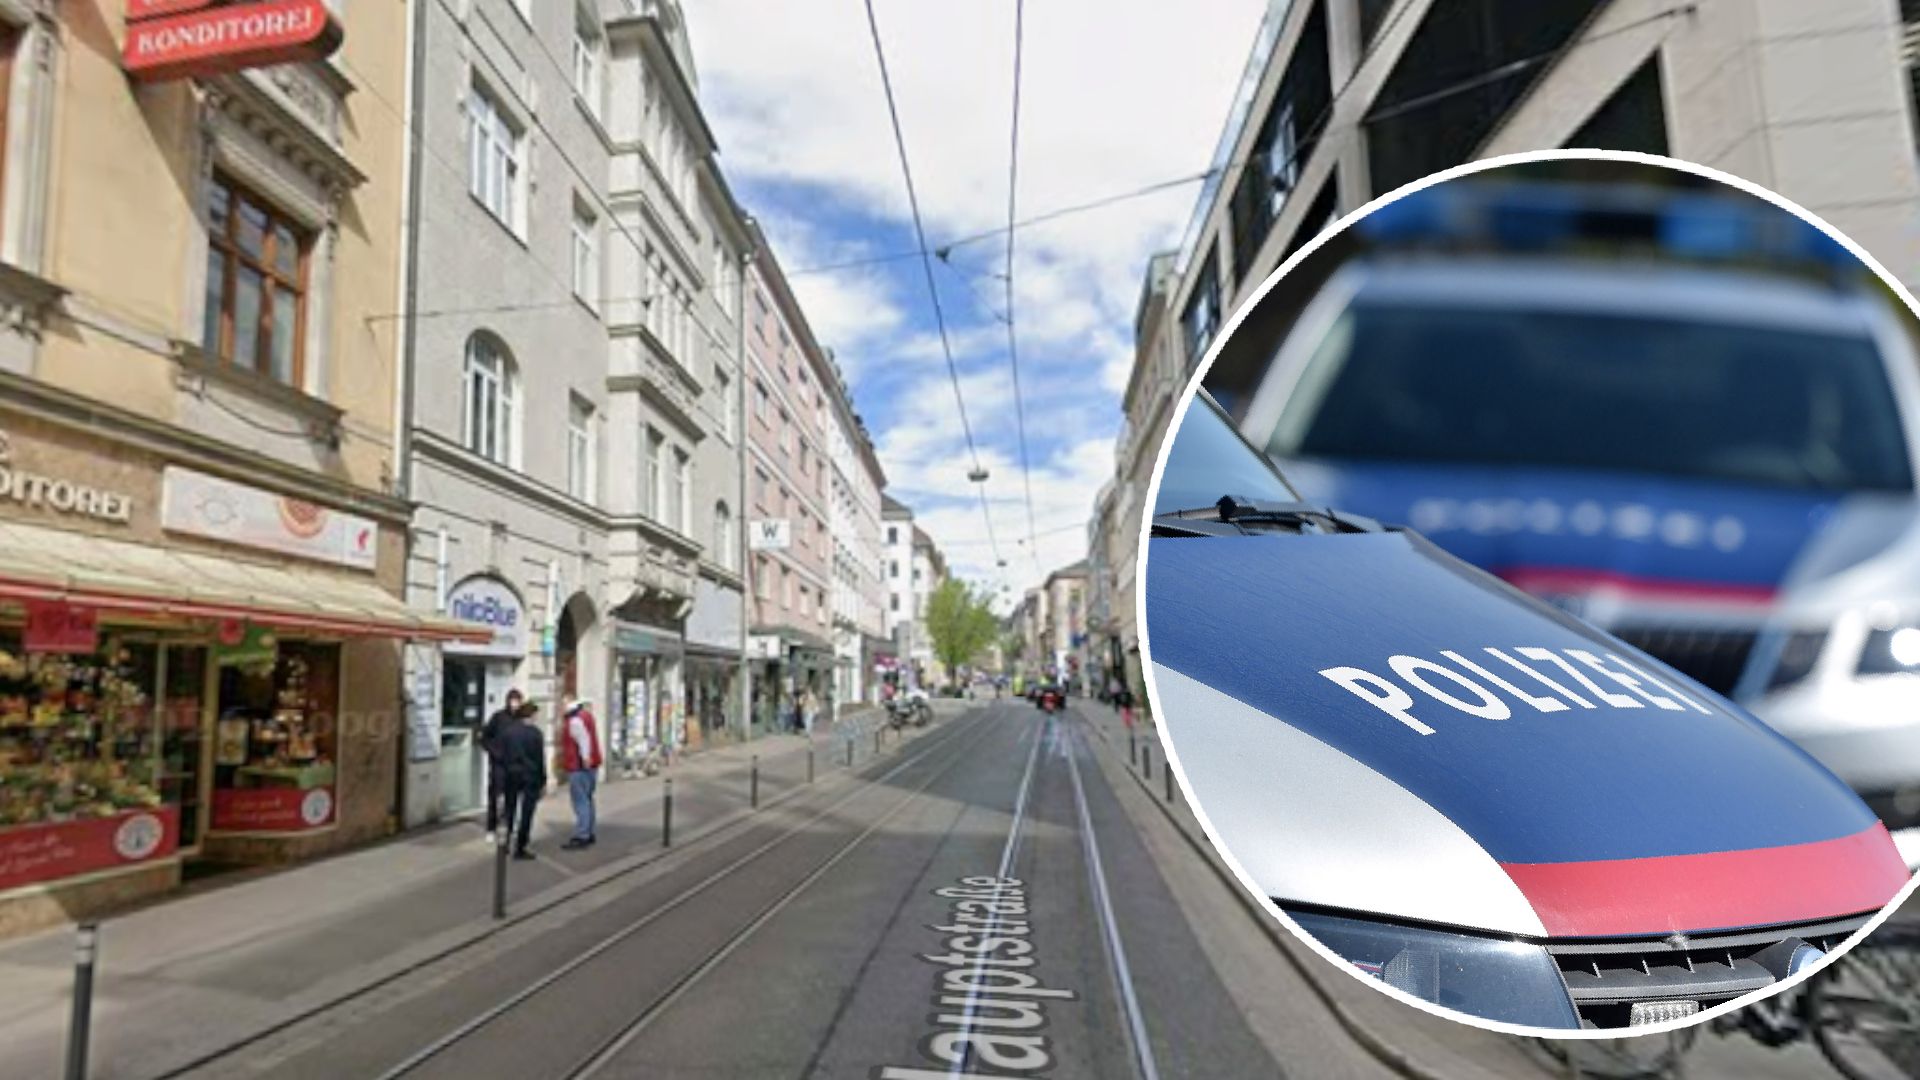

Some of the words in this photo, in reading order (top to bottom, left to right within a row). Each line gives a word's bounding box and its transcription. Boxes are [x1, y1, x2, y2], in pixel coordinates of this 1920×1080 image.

[137, 6, 313, 55] KONDITOREI
[762, 521, 778, 538] W
[1317, 646, 1713, 736] POLIZEI
